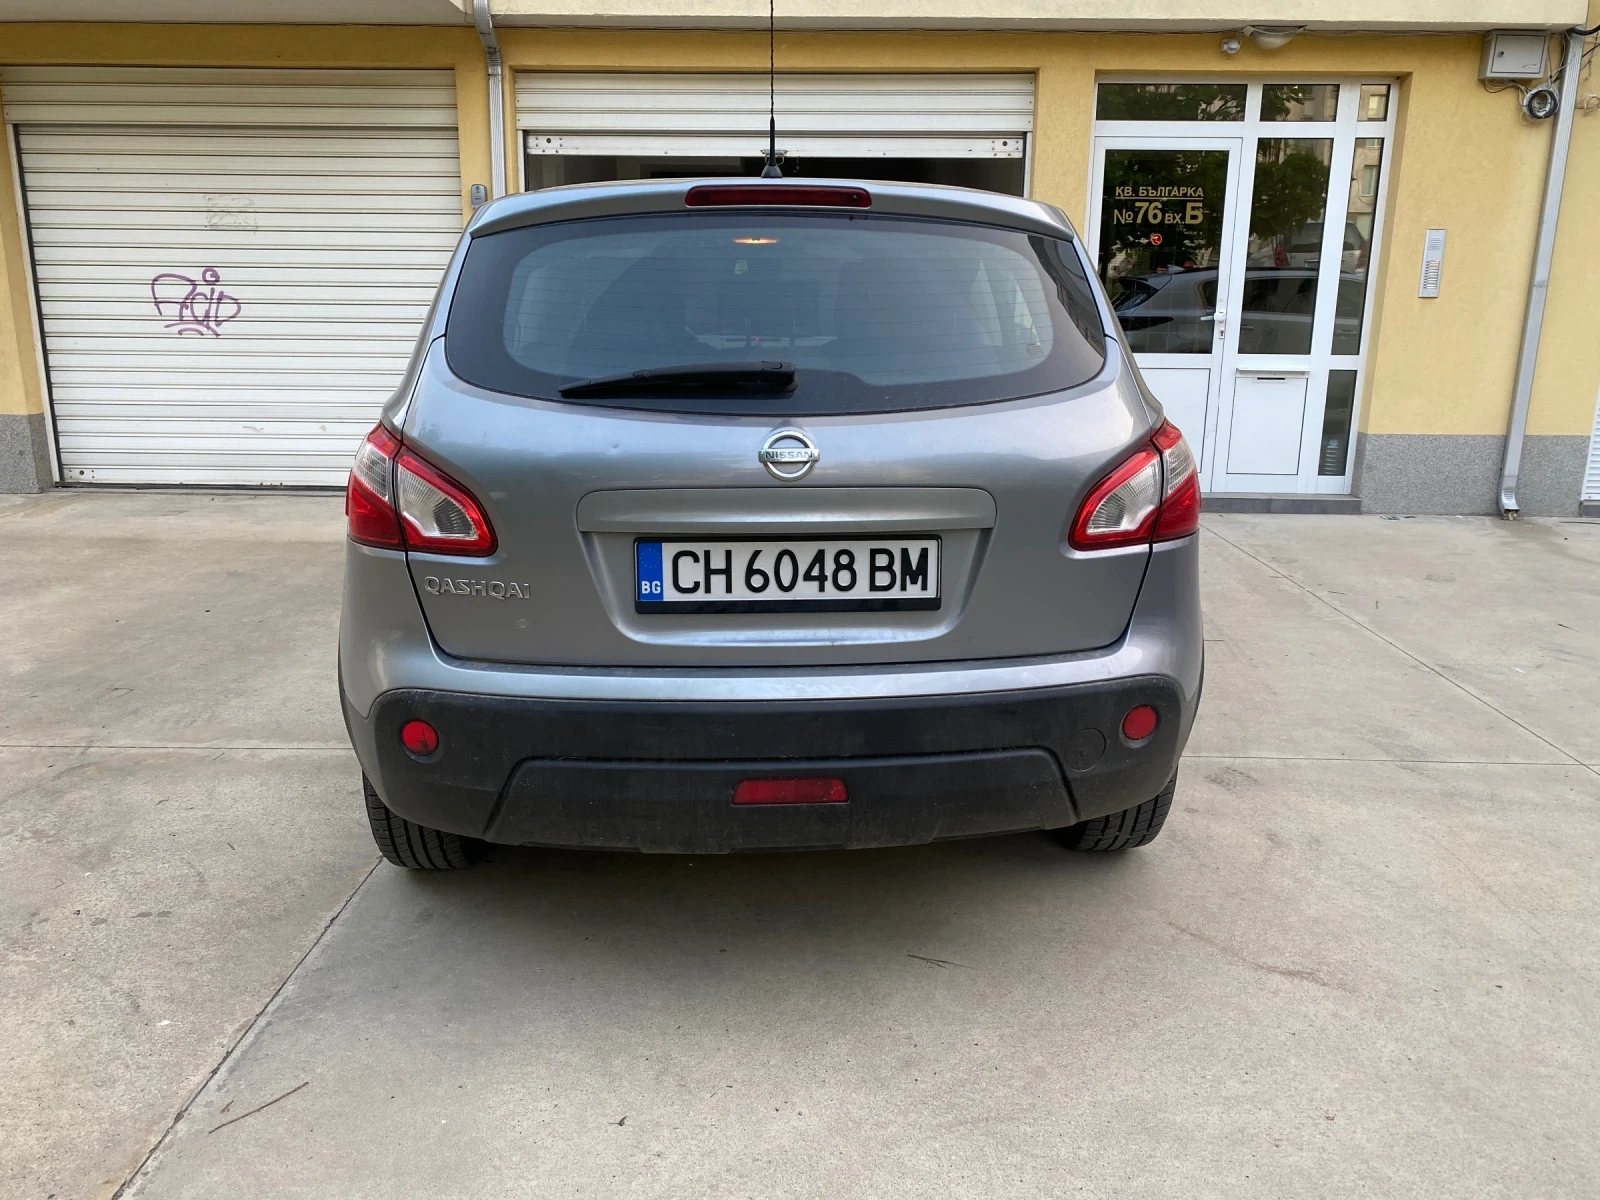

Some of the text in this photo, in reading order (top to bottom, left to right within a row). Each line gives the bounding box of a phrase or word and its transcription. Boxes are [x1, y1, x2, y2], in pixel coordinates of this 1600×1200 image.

[1138, 186, 1204, 197] БЪЛГАРКА
[765, 451, 813, 459] NISSAN
[424, 576, 530, 600] QASHQAI
[641, 580, 661, 594] BG
